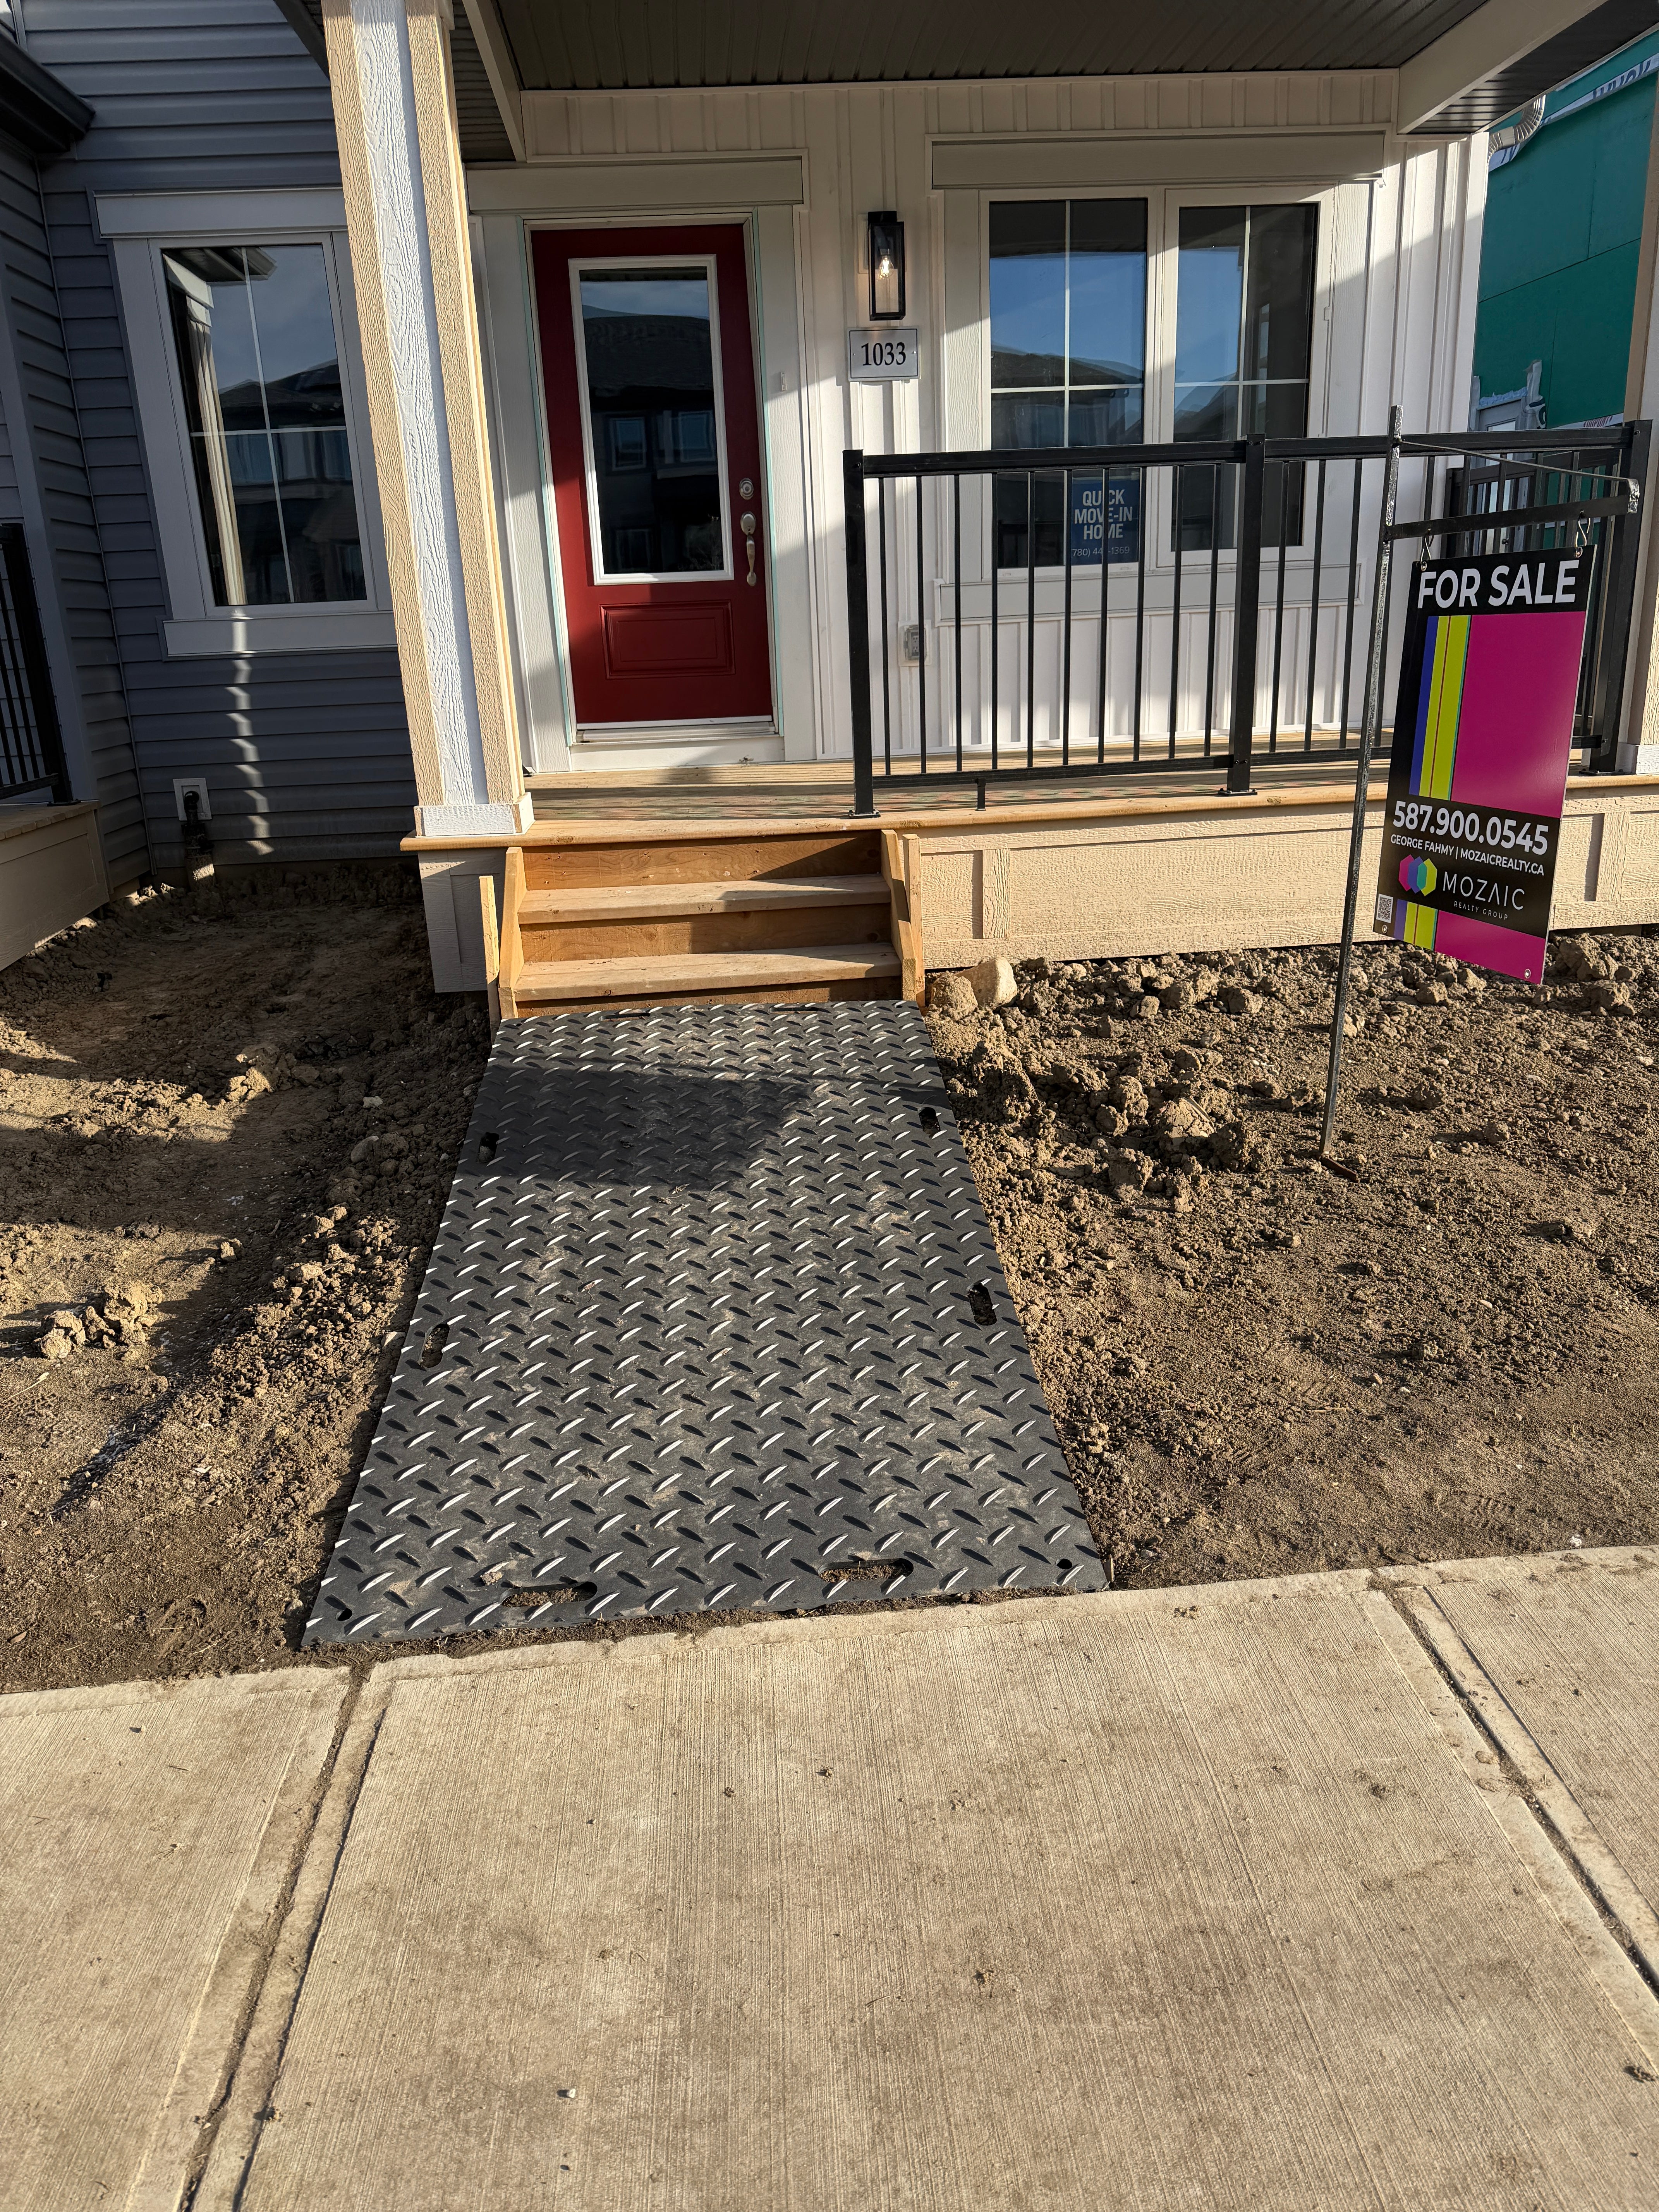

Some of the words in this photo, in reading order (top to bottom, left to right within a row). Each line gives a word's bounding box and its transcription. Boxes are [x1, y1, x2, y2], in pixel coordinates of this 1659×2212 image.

[861, 342, 906, 366] 1033
[1082, 489, 1125, 506] QUCK
[1093, 546, 1130, 555] 44-1369
[1417, 568, 1481, 609] FOR
[1488, 560, 1580, 606] SALE
[1393, 800, 1549, 855] 587.900.0545
[1391, 834, 1422, 849] GEORGE
[1424, 841, 1454, 856] FAHMY
[1460, 848, 1544, 876] MOZAICREALTY.CA
[1443, 871, 1525, 910] MOZAIC
[1454, 901, 1479, 913] REALTY
[1483, 908, 1508, 920] GROUP
